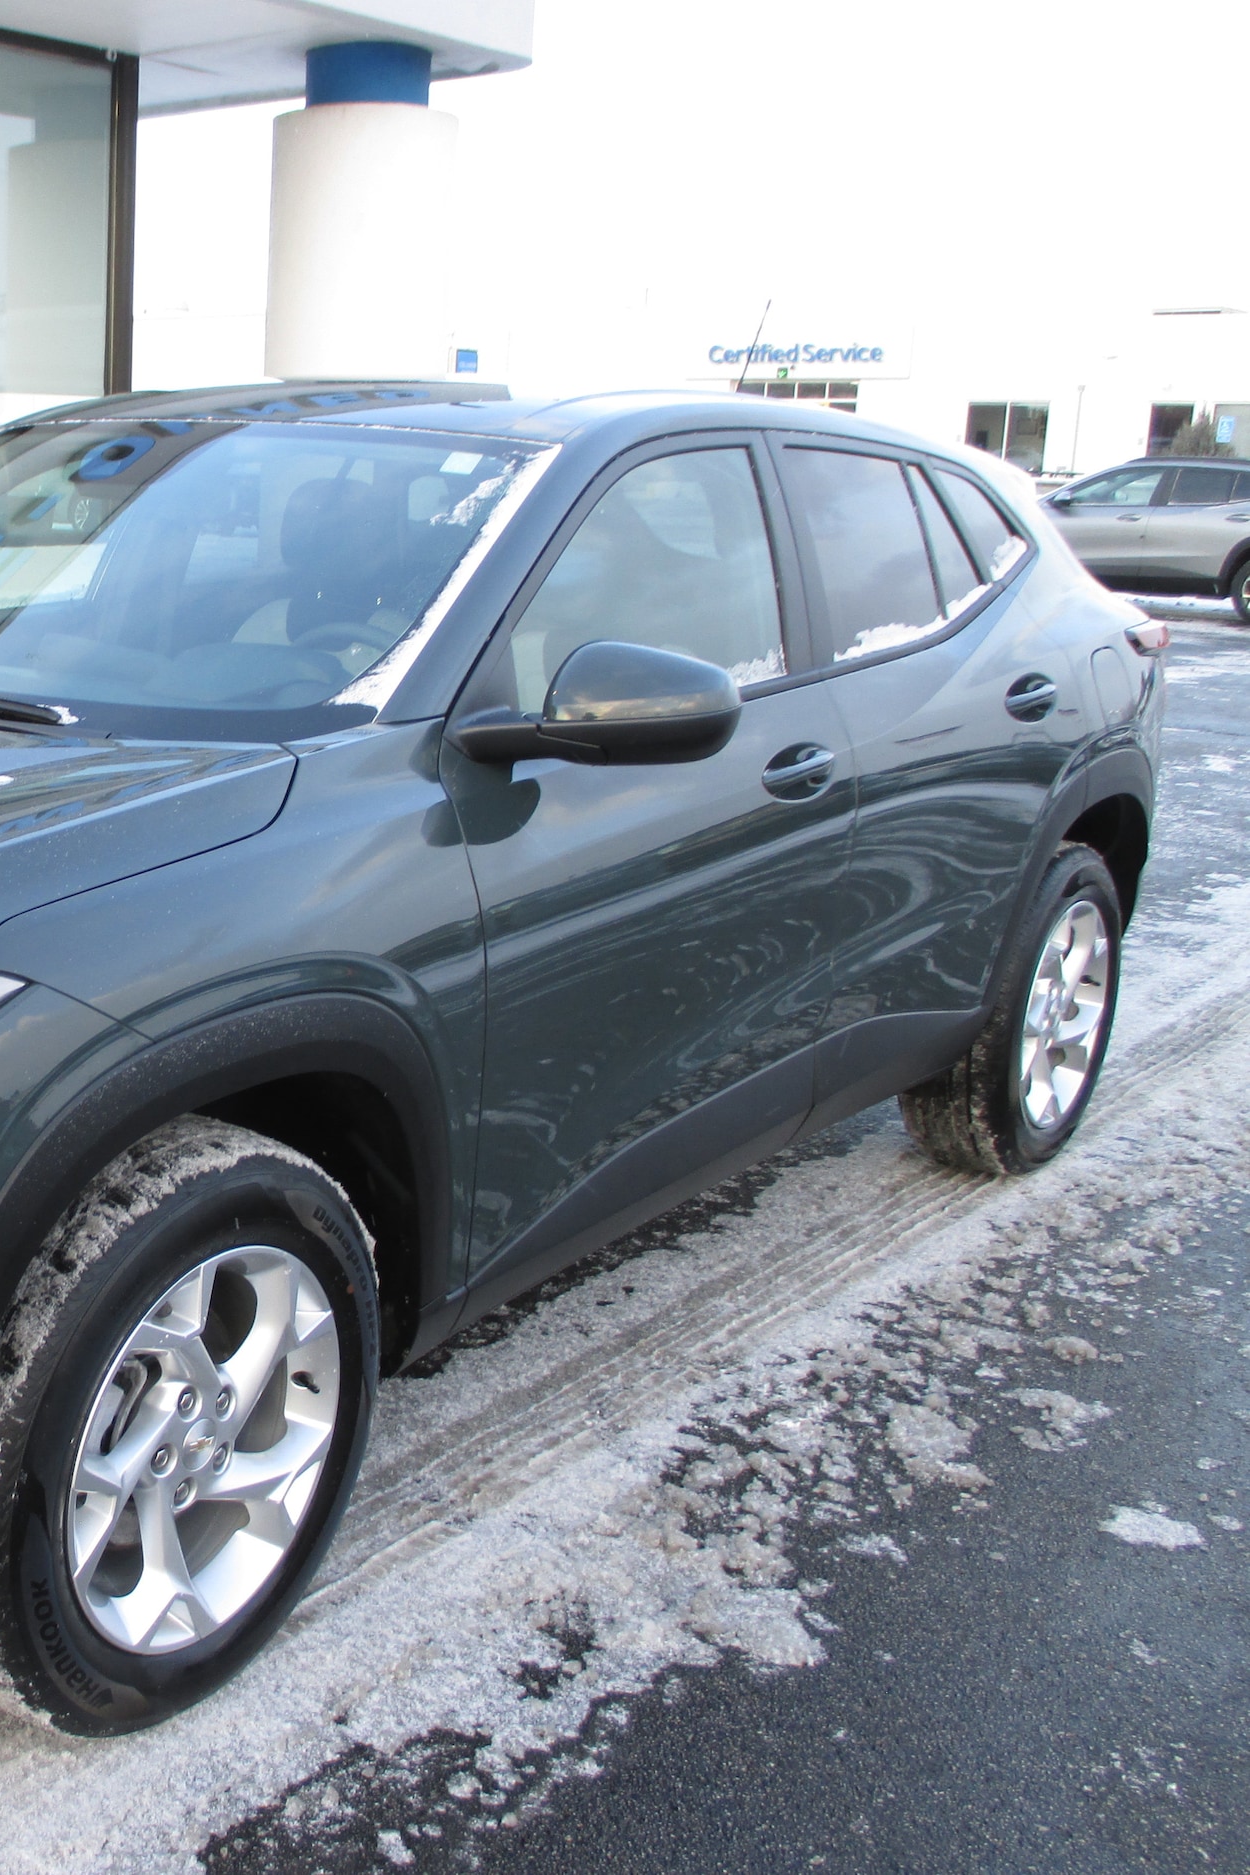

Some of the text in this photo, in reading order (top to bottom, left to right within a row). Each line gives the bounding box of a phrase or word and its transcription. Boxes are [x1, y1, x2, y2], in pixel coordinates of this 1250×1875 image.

[708, 344, 884, 364] Certified Service
[312, 1204, 369, 1292] Dynapro
